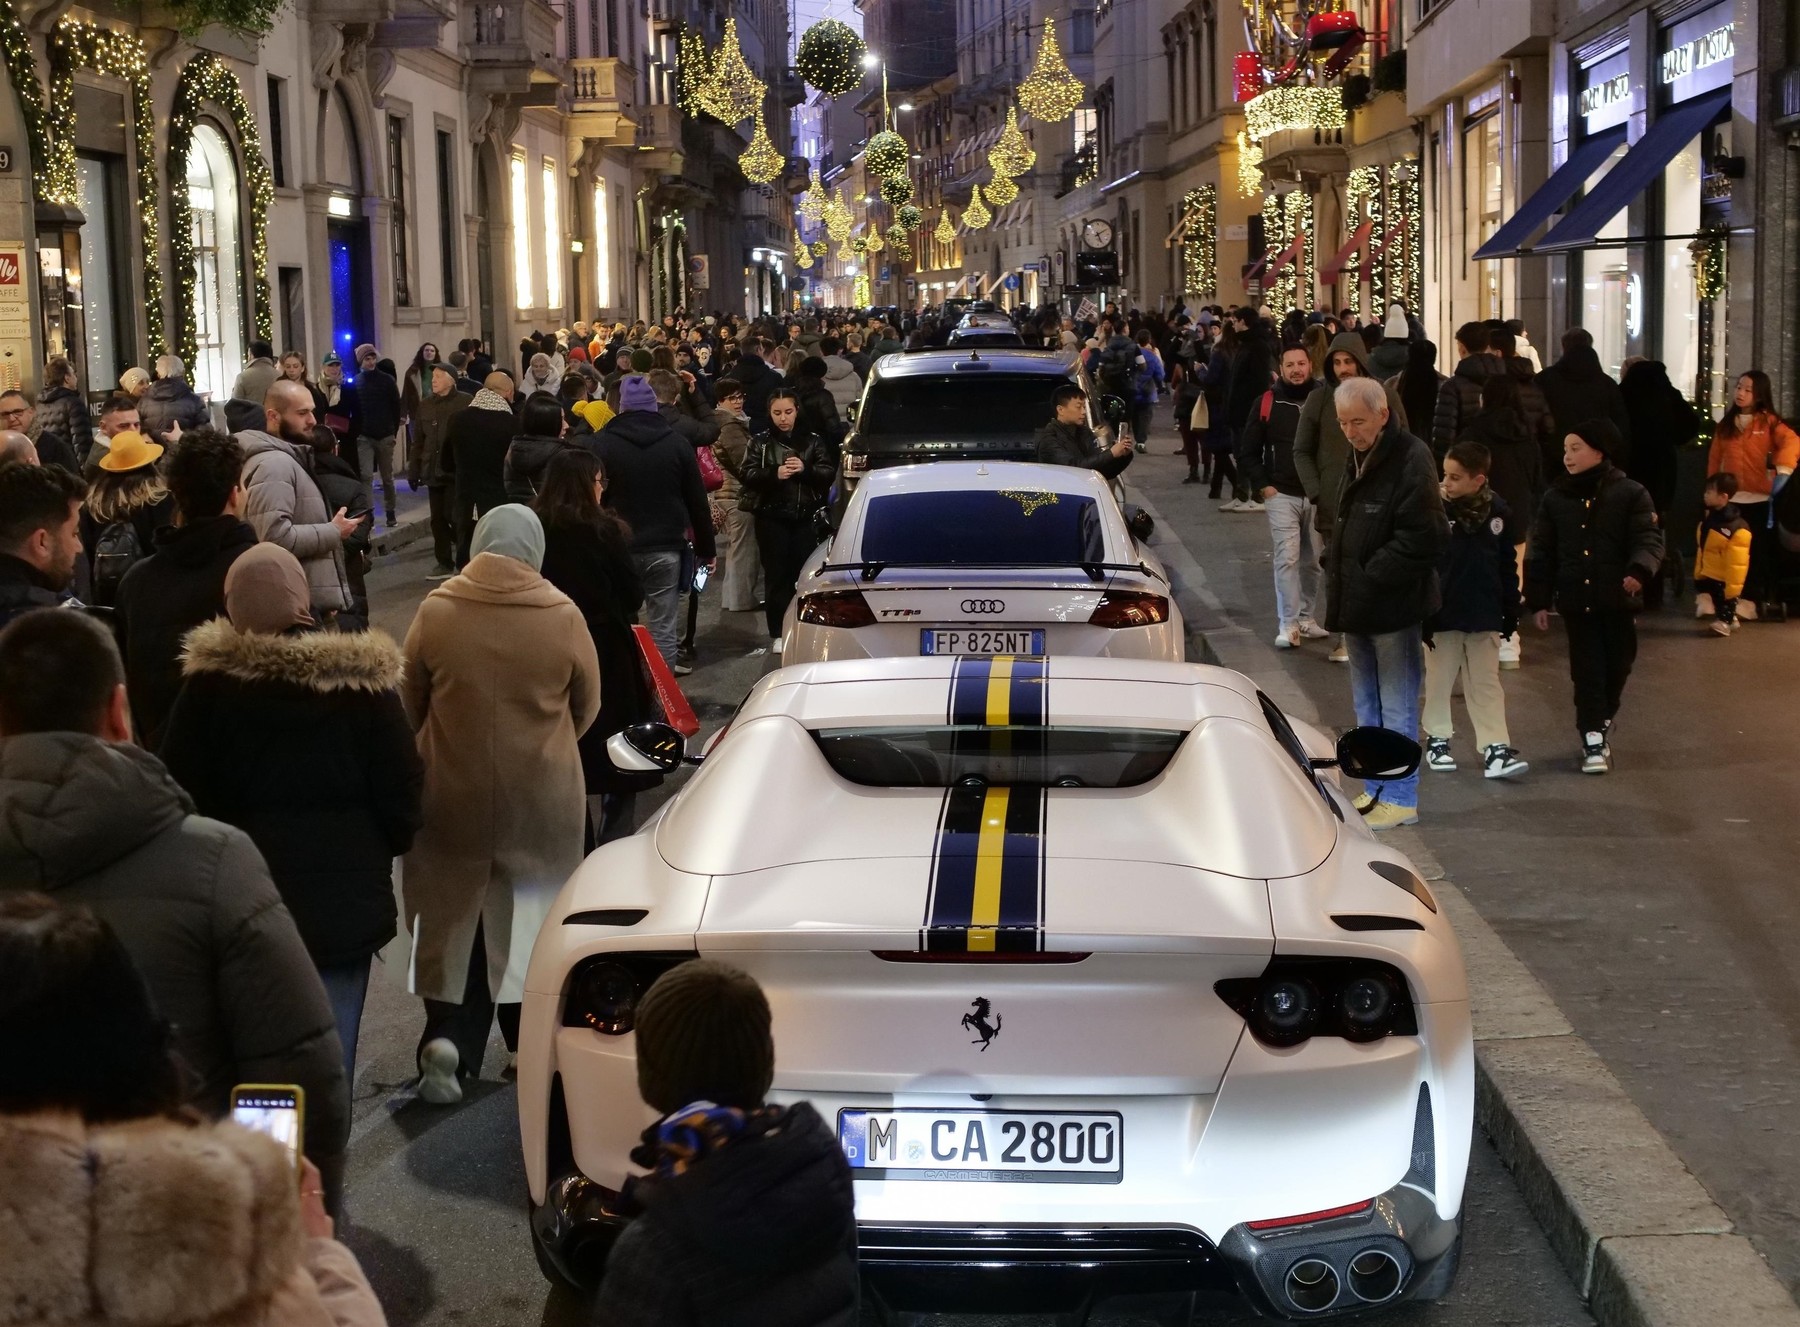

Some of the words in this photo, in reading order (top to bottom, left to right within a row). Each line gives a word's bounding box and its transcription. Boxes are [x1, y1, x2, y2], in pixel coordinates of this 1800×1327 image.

[1663, 43, 1693, 84] HARRY
[936, 632, 960, 653] FP
[967, 632, 1029, 653] 825NT
[847, 1145, 858, 1159] D
[869, 1118, 898, 1161] M
[931, 1120, 988, 1162] CA
[1001, 1120, 1114, 1164] 2800
